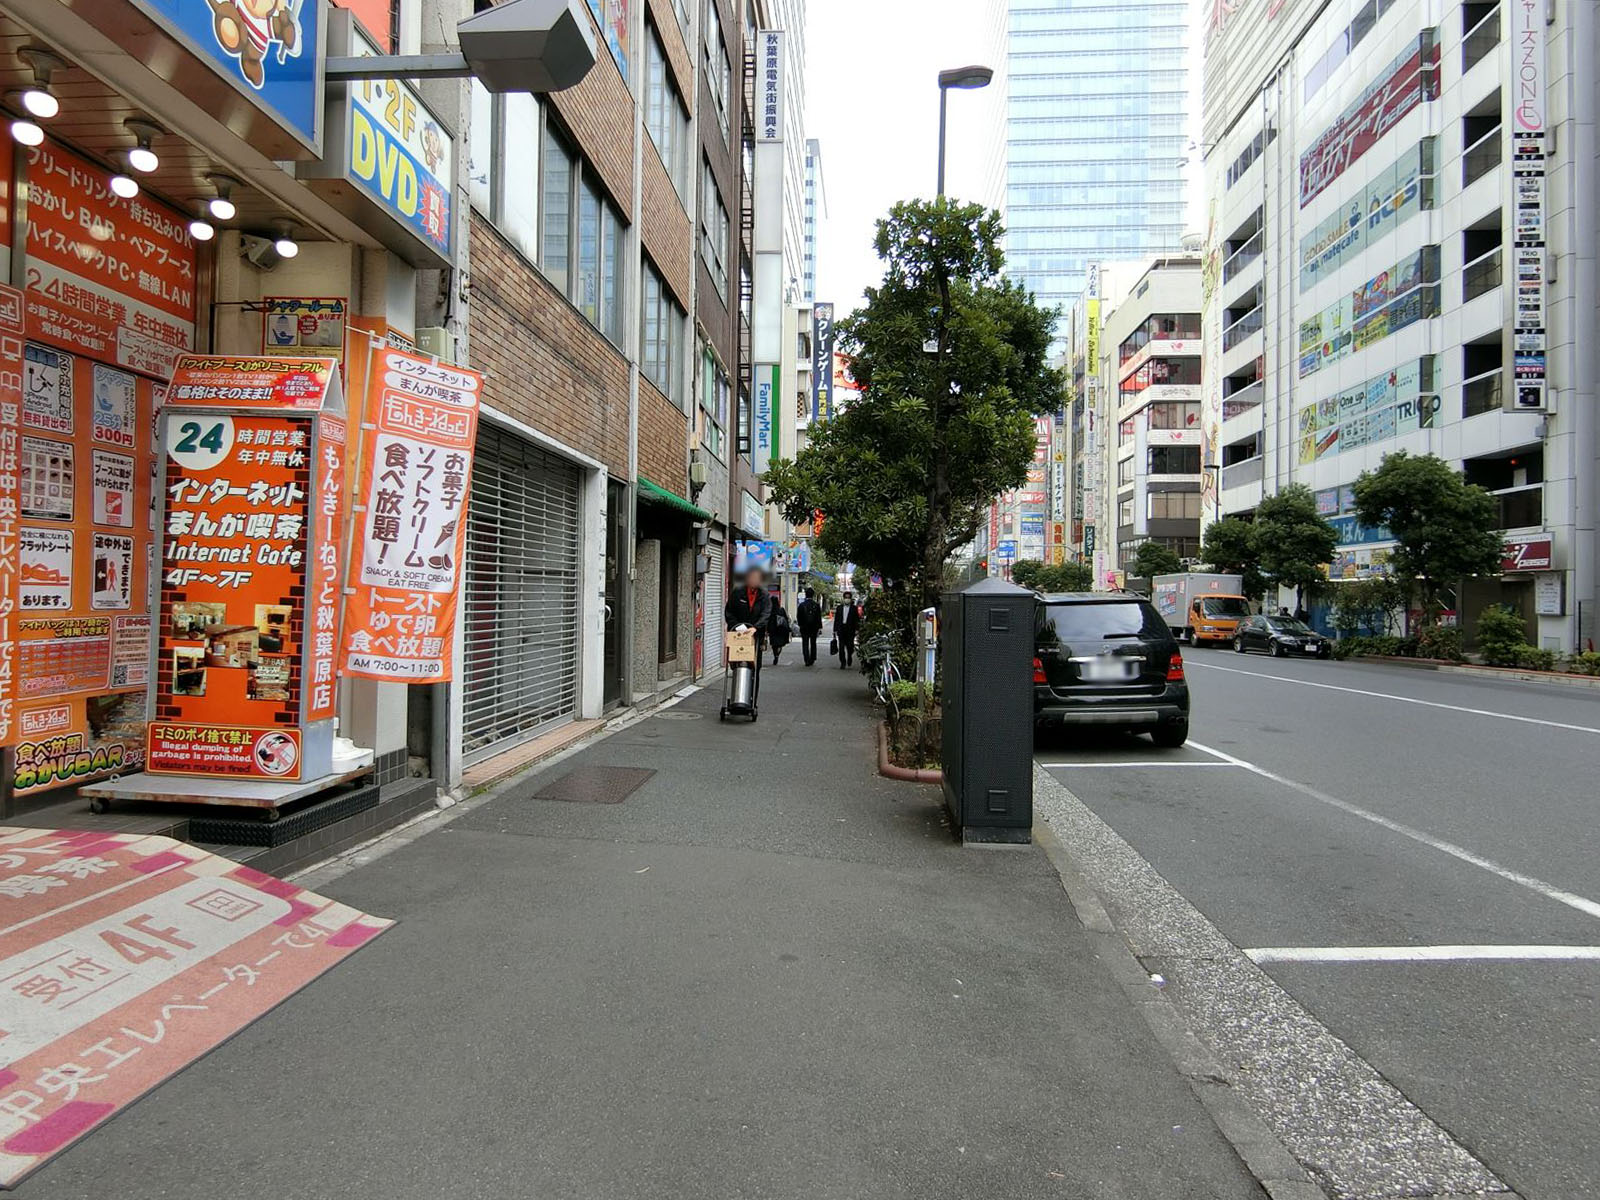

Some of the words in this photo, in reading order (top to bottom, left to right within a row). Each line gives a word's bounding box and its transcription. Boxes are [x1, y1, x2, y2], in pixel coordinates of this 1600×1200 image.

[765, 34, 778, 139] 秋葉原電気街振興会
[352, 108, 419, 218] DVD
[27, 181, 75, 221] おかし
[26, 267, 127, 326] 24時間営業
[133, 310, 189, 349] 年中無休
[817, 320, 829, 391] クレーンゲーム
[394, 359, 471, 387] インターネット
[177, 385, 273, 400] 価格はそのまま!!
[400, 377, 462, 403] まんが喫茶
[758, 383, 771, 449] FamilyMart
[95, 426, 133, 446] 300円
[175, 422, 225, 454] 24
[237, 429, 306, 446] 時間営業
[238, 449, 305, 467] 年中無休
[169, 478, 304, 507] インターネット
[441, 453, 465, 510] お菓子
[372, 442, 410, 565] 食べ放題!
[404, 447, 436, 567] ソフトクリーム
[168, 511, 303, 540] まんが喫茶
[20, 540, 71, 553] フラットシート
[95, 536, 131, 551] 途中外出
[166, 541, 251, 563] Internet
[256, 543, 302, 567] Cafe
[313, 446, 340, 711] もんきーねっと秋葉原店
[366, 566, 392, 577] SNACK
[394, 570, 401, 578] &
[403, 571, 426, 580] SOFT
[427, 574, 452, 583] CREAM
[387, 578, 405, 586] EAT
[407, 580, 430, 590] FREE
[22, 594, 67, 607] あります。
[369, 587, 442, 614] トースト
[369, 610, 437, 636] ゆで卵
[348, 629, 445, 658] 食べ放題!
[353, 658, 371, 669] AM
[373, 660, 440, 673] 7:00～11:00
[17, 734, 82, 764] 食べ放題
[155, 727, 253, 745] ゴミのポイ捨て禁止
[162, 741, 189, 750] Illegal
[192, 744, 230, 754] dumping
[15, 745, 123, 789] おかしBAR
[152, 751, 190, 759] garbage
[204, 753, 253, 763] prohibited.
[154, 760, 192, 769] Violators
[194, 764, 212, 772] may
[97, 914, 197, 965] 4F
[12, 957, 112, 1003] 受付
